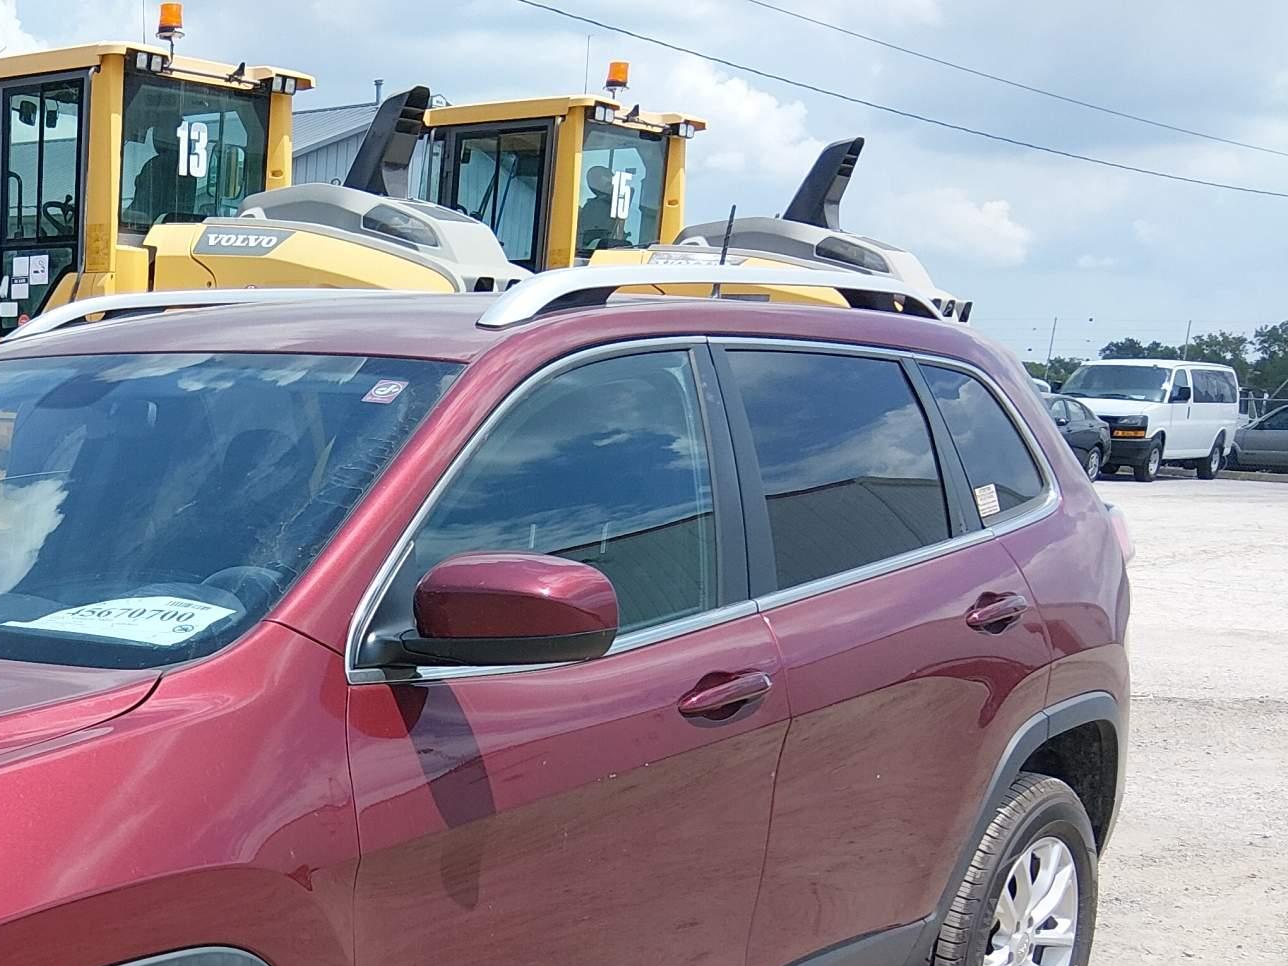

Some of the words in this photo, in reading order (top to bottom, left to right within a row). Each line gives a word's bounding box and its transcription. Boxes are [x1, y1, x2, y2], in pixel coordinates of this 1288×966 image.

[176, 121, 208, 178] 13
[610, 171, 633, 220] 15
[207, 233, 278, 248] VOLVO
